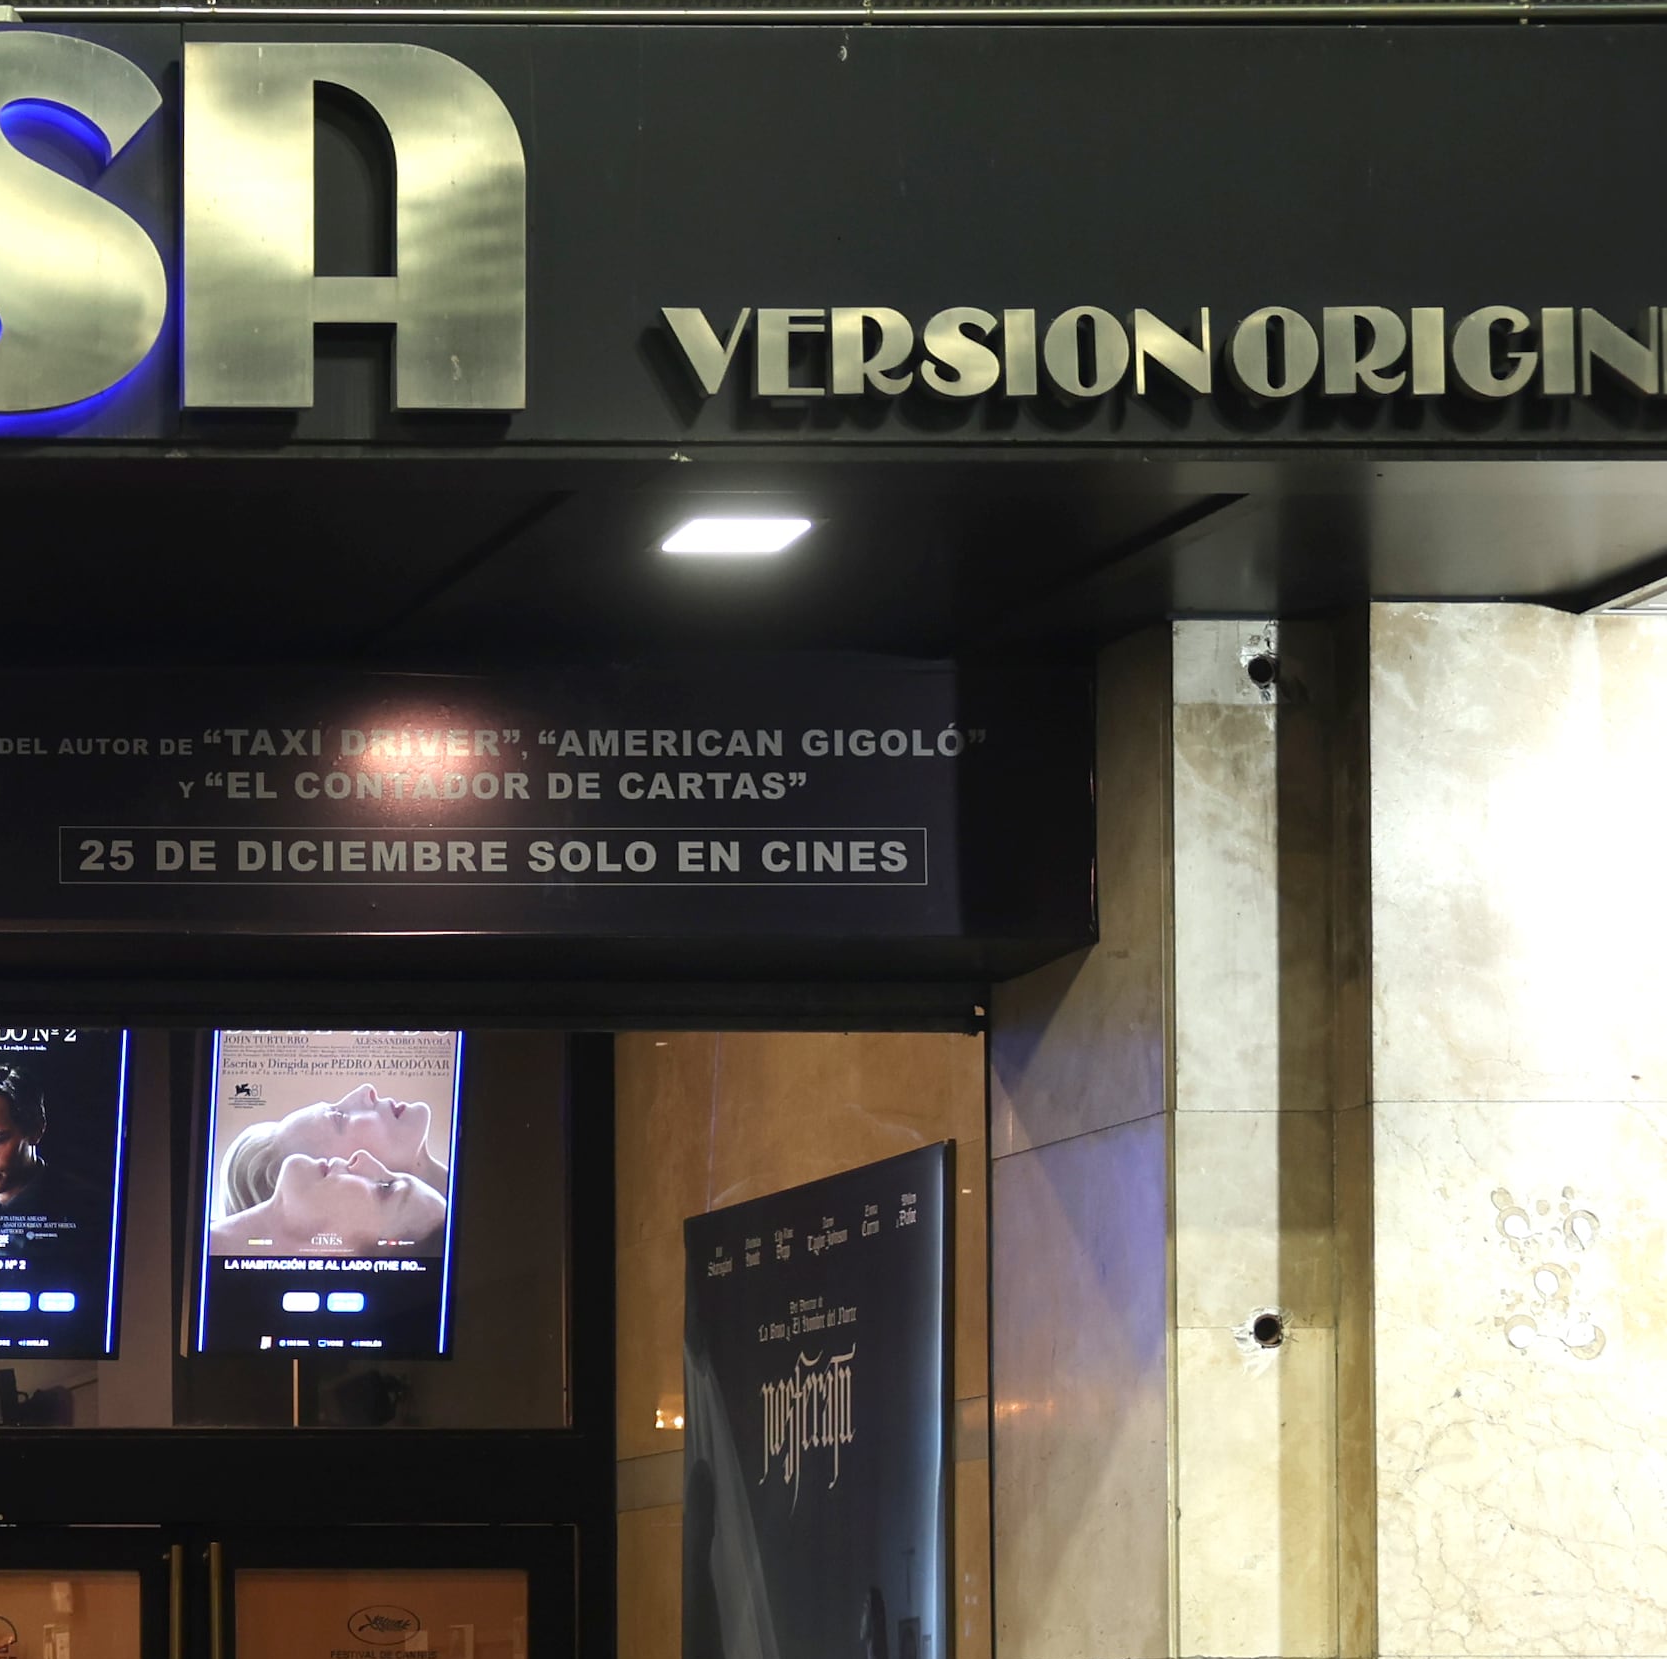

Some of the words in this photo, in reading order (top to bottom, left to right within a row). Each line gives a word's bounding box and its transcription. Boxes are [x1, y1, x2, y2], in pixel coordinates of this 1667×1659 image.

[660, 305, 1213, 397] VERSION
[1231, 304, 1667, 398] ORIGIN
[57, 736, 153, 757] AUTOR
[158, 736, 193, 757] DE
[178, 780, 195, 799] Y
[293, 771, 531, 800] CONTADOR
[546, 771, 603, 800] DE
[77, 838, 136, 873] 25
[154, 839, 218, 873] DE
[237, 839, 509, 873] DICIEMBRE
[526, 839, 660, 873] SOLO
[675, 839, 744, 873] EN
[760, 839, 911, 873] CINES
[223, 1058, 257, 1069] Escrita
[311, 1061, 329, 1071] por
[331, 1058, 373, 1069] PEDRO
[374, 1056, 450, 1069] ALMODÓVAR
[310, 1236, 343, 1247] CINES
[18, 1259, 27, 1270] 2
[224, 1259, 240, 1271] LA
[240, 1257, 309, 1271] HABITACIÓN
[310, 1259, 324, 1271] DE
[324, 1259, 341, 1271] AL
[341, 1259, 373, 1271] LADO
[373, 1260, 399, 1273] (THE
[330, 1650, 376, 1659] FESTIVAL
[379, 1650, 393, 1659] DE
